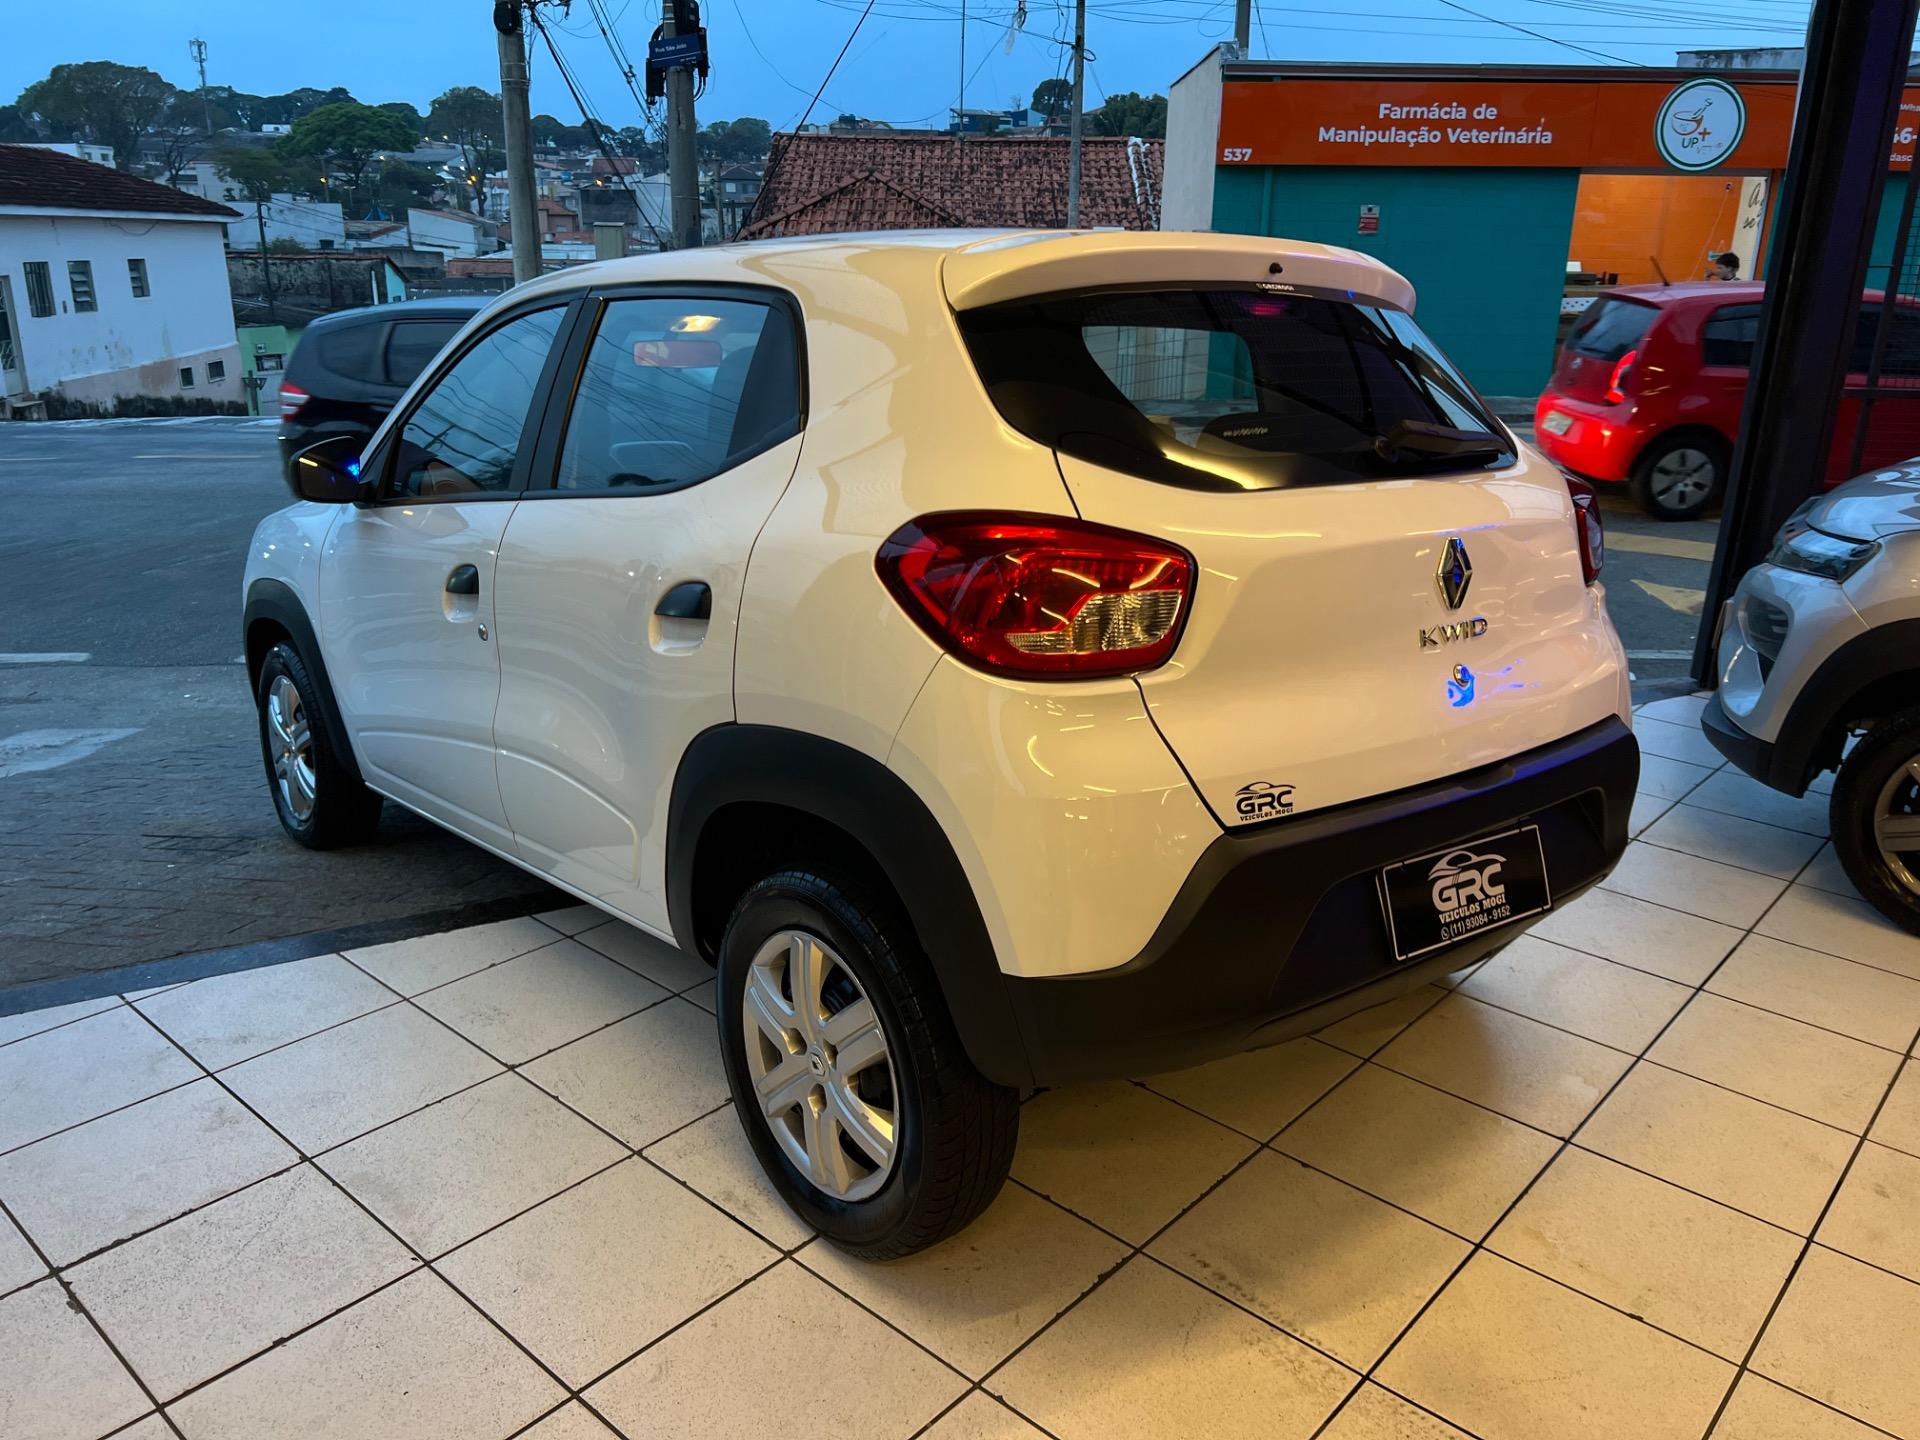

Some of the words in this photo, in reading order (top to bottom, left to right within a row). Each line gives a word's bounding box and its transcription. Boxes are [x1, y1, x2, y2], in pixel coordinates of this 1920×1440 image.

[1378, 102, 1466, 120] Farmácia
[1472, 103, 1498, 120] de
[1317, 125, 1442, 148] Manipulação
[1446, 126, 1553, 145] Veterinária
[1223, 147, 1253, 161] 537
[1418, 618, 1489, 649] KWID
[1236, 789, 1293, 815] GRC
[1240, 811, 1273, 822] VEICULOS
[1432, 862, 1505, 912] GRC
[1439, 902, 1480, 925] VEICULOS
[1482, 893, 1506, 910] MOGI
[1450, 920, 1466, 938] (11)
